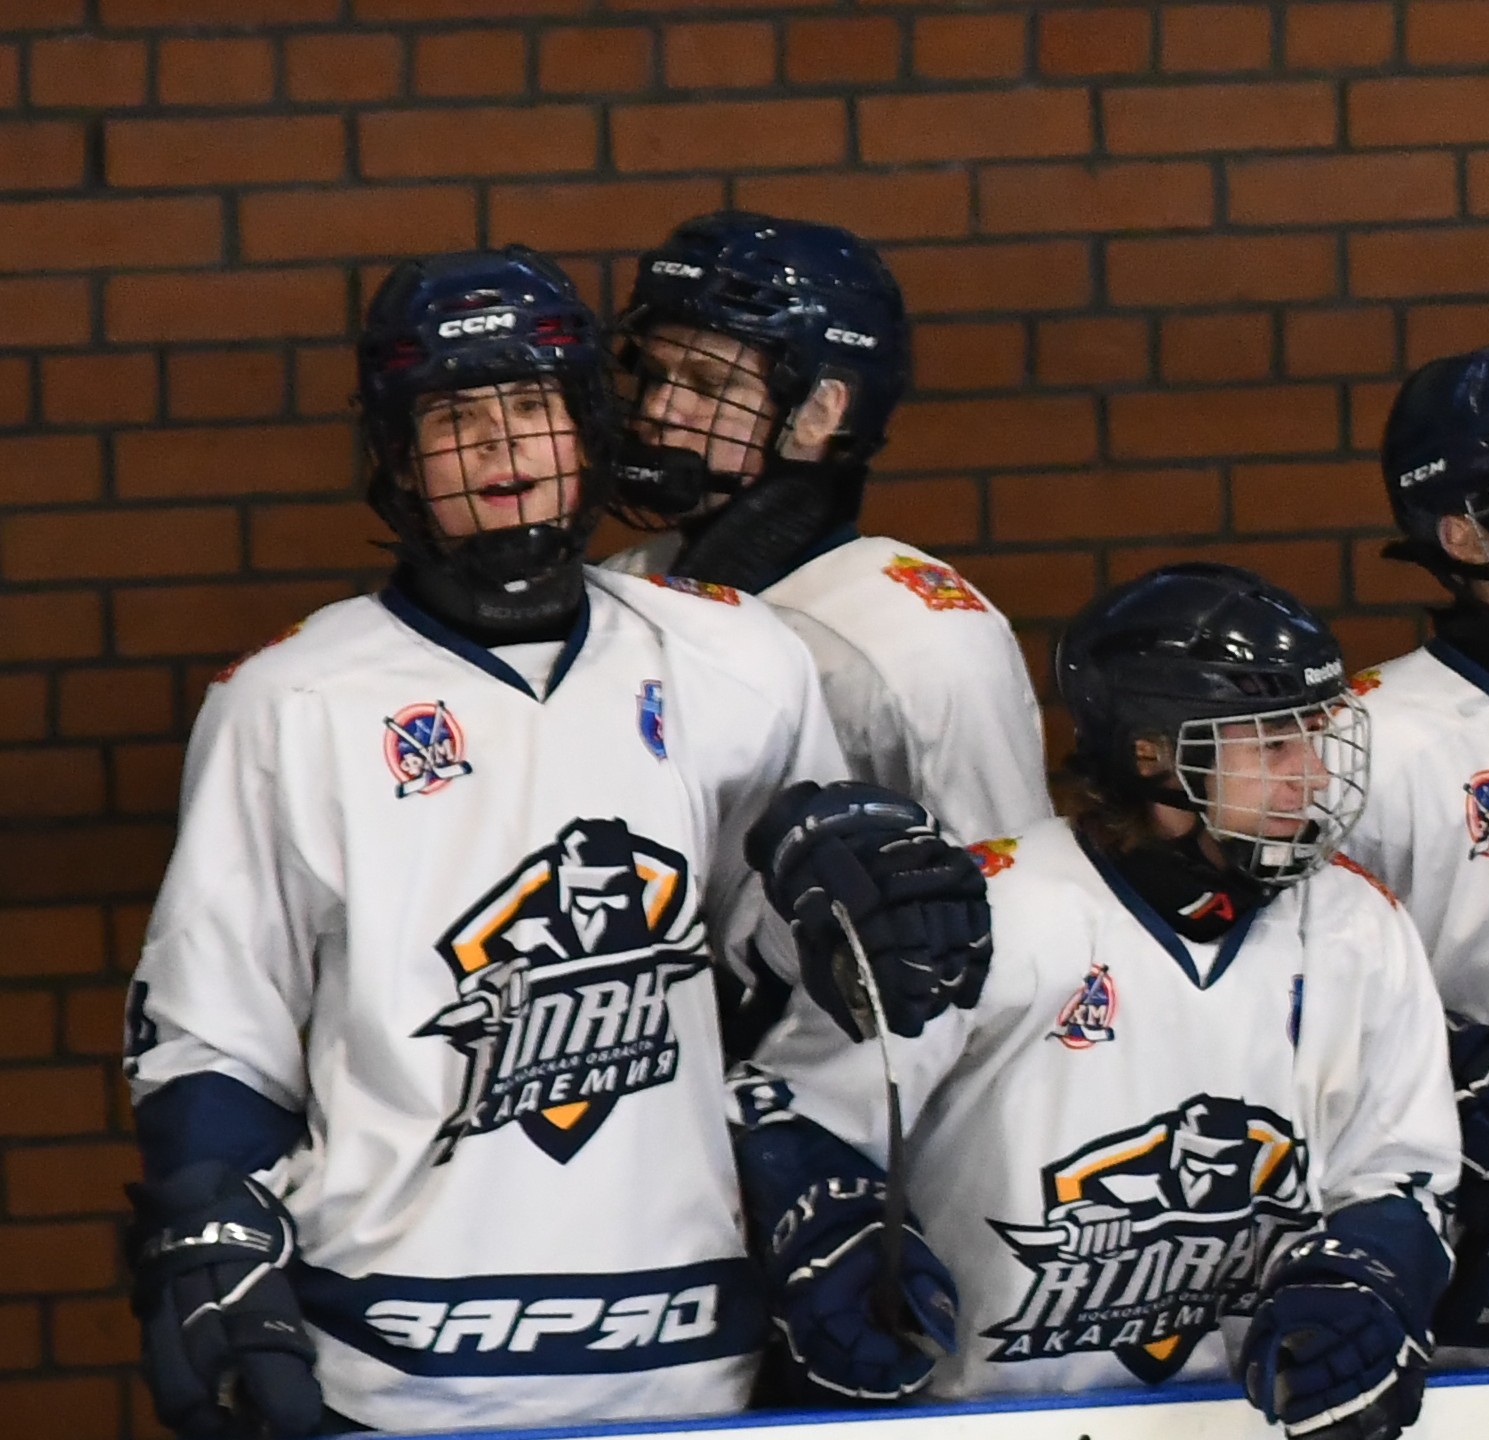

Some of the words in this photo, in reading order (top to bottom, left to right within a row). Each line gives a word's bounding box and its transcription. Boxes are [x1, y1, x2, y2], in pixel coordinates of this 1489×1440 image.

[652, 260, 703, 279] CCM
[439, 313, 515, 338] CCM
[825, 327, 877, 349] CCM
[1400, 458, 1446, 487] CCM
[364, 1284, 719, 1355] ЗАРЯД
